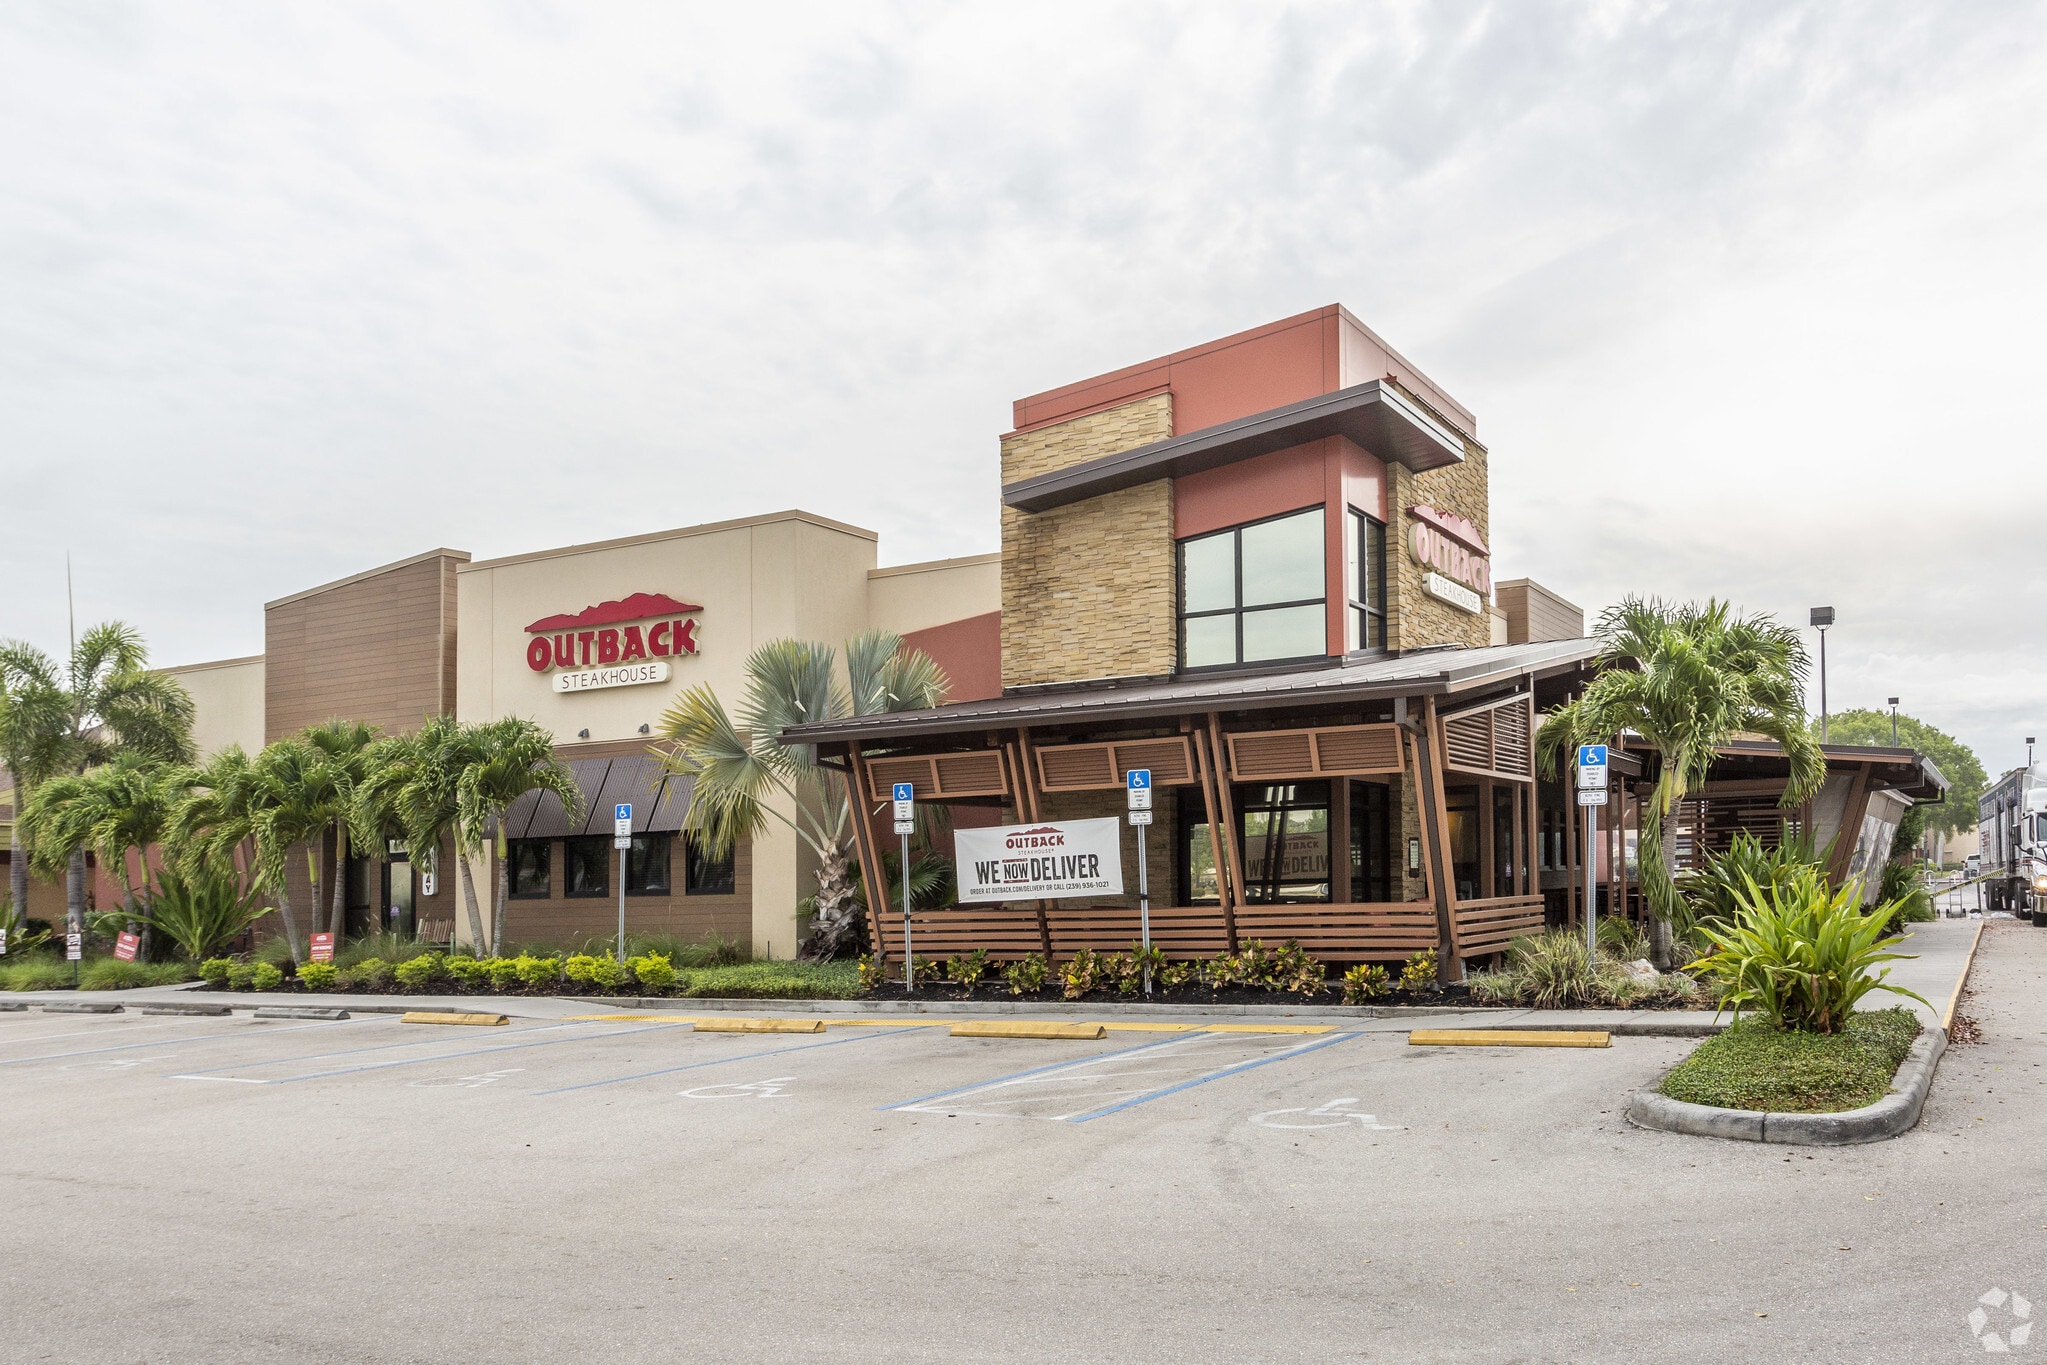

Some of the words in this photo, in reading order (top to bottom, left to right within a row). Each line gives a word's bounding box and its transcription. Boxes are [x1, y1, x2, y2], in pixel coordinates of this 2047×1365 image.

[1413, 522, 1491, 597] OUTBACK
[1433, 577, 1479, 610] STEAKHOUSE
[527, 618, 697, 672] OUTBACK
[562, 665, 657, 689] STEAKHOUSE
[1005, 835, 1065, 849] OUTBACK
[975, 860, 1000, 885] WE
[1003, 862, 1029, 880] NOW
[1030, 854, 1100, 882] DELIVER
[991, 884, 1045, 894] OUTBACK.COM/DELIVERY
[1053, 883, 1065, 891] CALL
[1066, 882, 1082, 891] (239)
[1082, 881, 1109, 889] 936-1021
